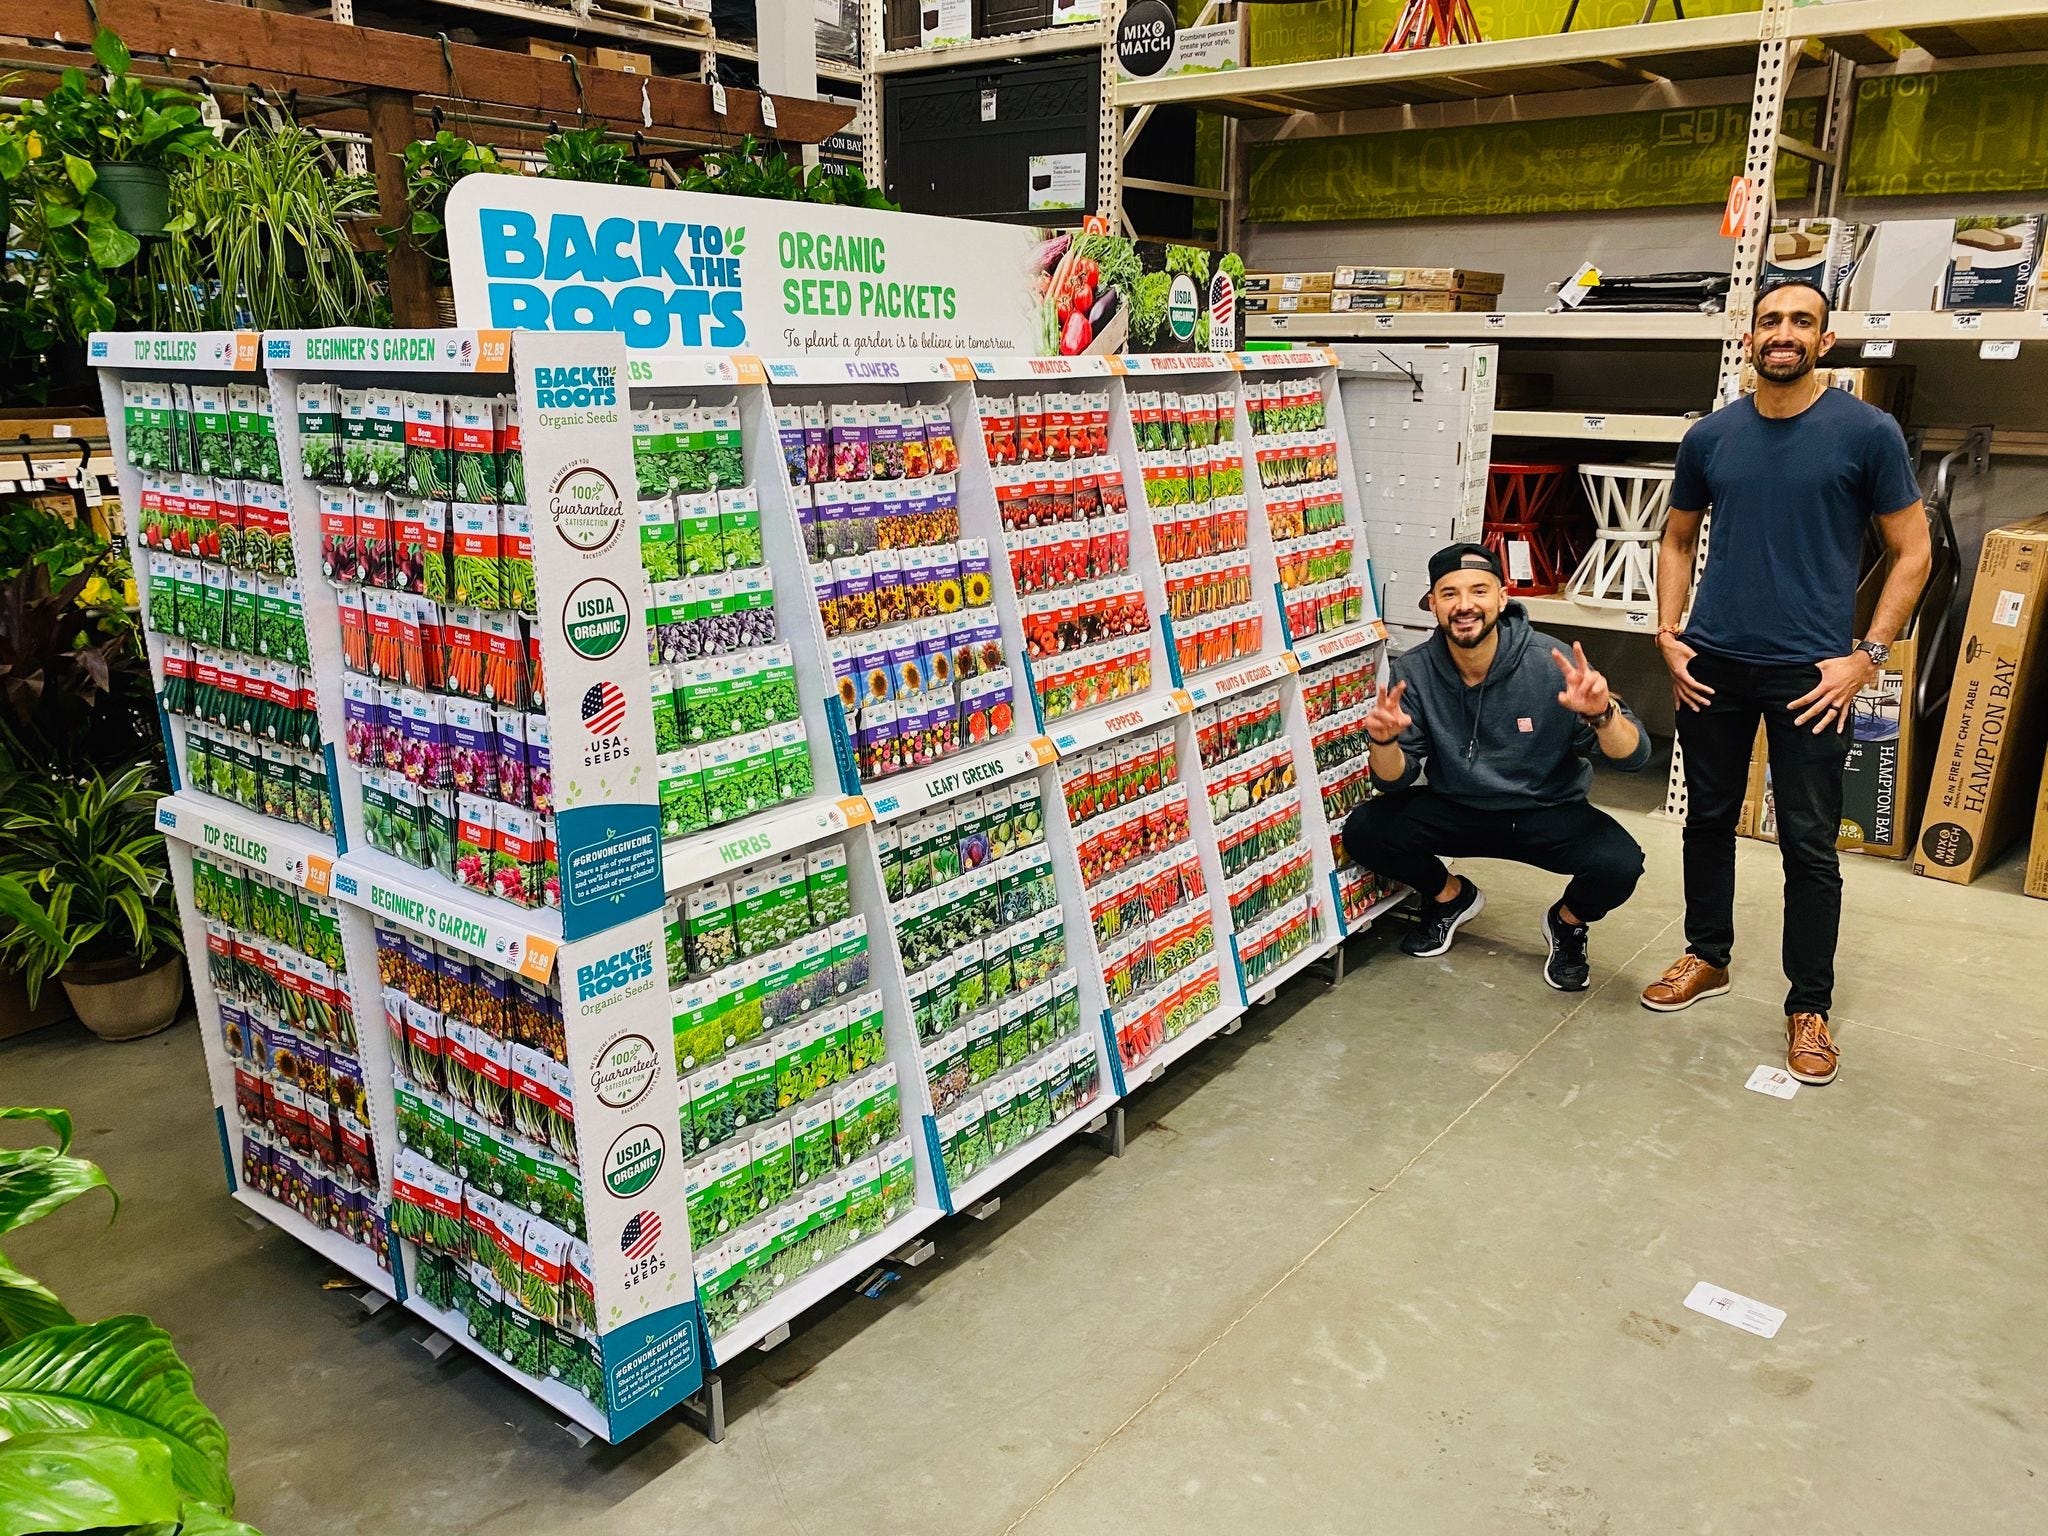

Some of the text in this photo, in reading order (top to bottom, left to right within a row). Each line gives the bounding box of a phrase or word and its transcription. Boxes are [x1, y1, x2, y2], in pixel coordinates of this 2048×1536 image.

[1124, 23, 1152, 40] MIX
[1180, 32, 1206, 42] Combine
[1207, 30, 1227, 39] pieces
[1120, 36, 1171, 56] MATCH
[1180, 42, 1200, 50] create
[1200, 40, 1214, 49] your
[1194, 50, 1207, 58] way
[846, 140, 862, 152] BAY
[778, 231, 886, 274] ORGANIC
[479, 208, 747, 348] BACK TO THE ROOTS
[783, 278, 956, 320] SEED PACKETS
[1175, 290, 1192, 305] USDA
[2013, 283, 2027, 307] BAY
[1172, 309, 1194, 323] ORGANIC
[1215, 327, 1229, 337] USA
[134, 340, 197, 361] TOP SELLERS
[307, 337, 436, 361] BEGINNER'S GARDEN
[783, 329, 1015, 356] To plant a garden is to believe in tomorrow.
[1211, 339, 1233, 348] SEEDS
[1029, 360, 1072, 374] TOMATOES
[1152, 357, 1214, 370] FRUITS & VEGGIES
[1262, 353, 1314, 365] FRUITS & VEGGIES
[535, 367, 598, 388] BACK
[598, 366, 609, 377] TO
[845, 362, 899, 378] FLOWERS
[598, 376, 615, 387] THE
[536, 387, 617, 408] ROOTS
[374, 422, 393, 434] Arugula
[539, 411, 618, 429] Organic Seeds
[418, 427, 432, 438] Bean
[716, 433, 729, 442] Basil
[569, 460, 578, 468] FOR
[550, 497, 623, 522] Guaranteed
[565, 518, 608, 527] SATISFACTION
[577, 597, 615, 618] USDA
[574, 619, 621, 641] ORGANIC
[490, 638, 506, 650] Carrot
[1319, 634, 1366, 655] FRUITS & VEGGIES
[1216, 665, 1272, 692] FRUITS & VEGGIES
[695, 686, 718, 696] Cilantro
[1964, 680, 1979, 712] TABLE
[411, 722, 430, 733] Cosmos
[1105, 711, 1144, 734] PEPPERS
[1958, 713, 1971, 740] CHAT
[591, 736, 622, 752] USA
[1964, 657, 2016, 813] HAMPTON BAY
[584, 747, 630, 767] SEEDS
[1955, 744, 1964, 758] PIT
[926, 760, 1004, 799] LEAFY GREENS
[1950, 762, 1961, 782] FIRE
[1875, 746, 1895, 842] HAMPTON BAY
[1948, 785, 1955, 794] IN
[1943, 795, 1953, 808] 42
[204, 824, 267, 865] TOP SELLERS
[573, 834, 653, 867] #GROWONEGIVEONE
[719, 833, 772, 864] HERBS
[1935, 838, 1948, 860] MIX
[1945, 827, 1961, 865] MATCH
[575, 868, 594, 878] Share
[600, 862, 609, 872] pic
[610, 858, 617, 867] of
[618, 855, 632, 866] your
[632, 848, 654, 861] garden
[575, 856, 655, 889] and we'll donate grow kit
[1915, 864, 1924, 875] 28
[590, 881, 610, 894] school
[611, 877, 618, 886] of
[618, 875, 632, 886] your
[371, 885, 488, 948] BEGINNER'S GARDEN
[577, 945, 653, 1003] BACK TO THE ROOTS
[764, 973, 790, 987] Lavender
[581, 980, 654, 1017] Organic Seeds
[271, 1033, 296, 1045] Sunflower
[591, 1052, 659, 1093] Guaranteed
[605, 1073, 646, 1092] SATISFACTION
[736, 1072, 771, 1089] Lemon Balm
[616, 1138, 651, 1166] USDA
[536, 1163, 558, 1178] Parsley
[613, 1155, 657, 1186] ORGANIC
[624, 1260, 666, 1290] SEEDS
[630, 1255, 658, 1276] USA
[706, 1281, 720, 1293] Sage
[616, 1327, 688, 1379] #GROWONEGIVEONE
